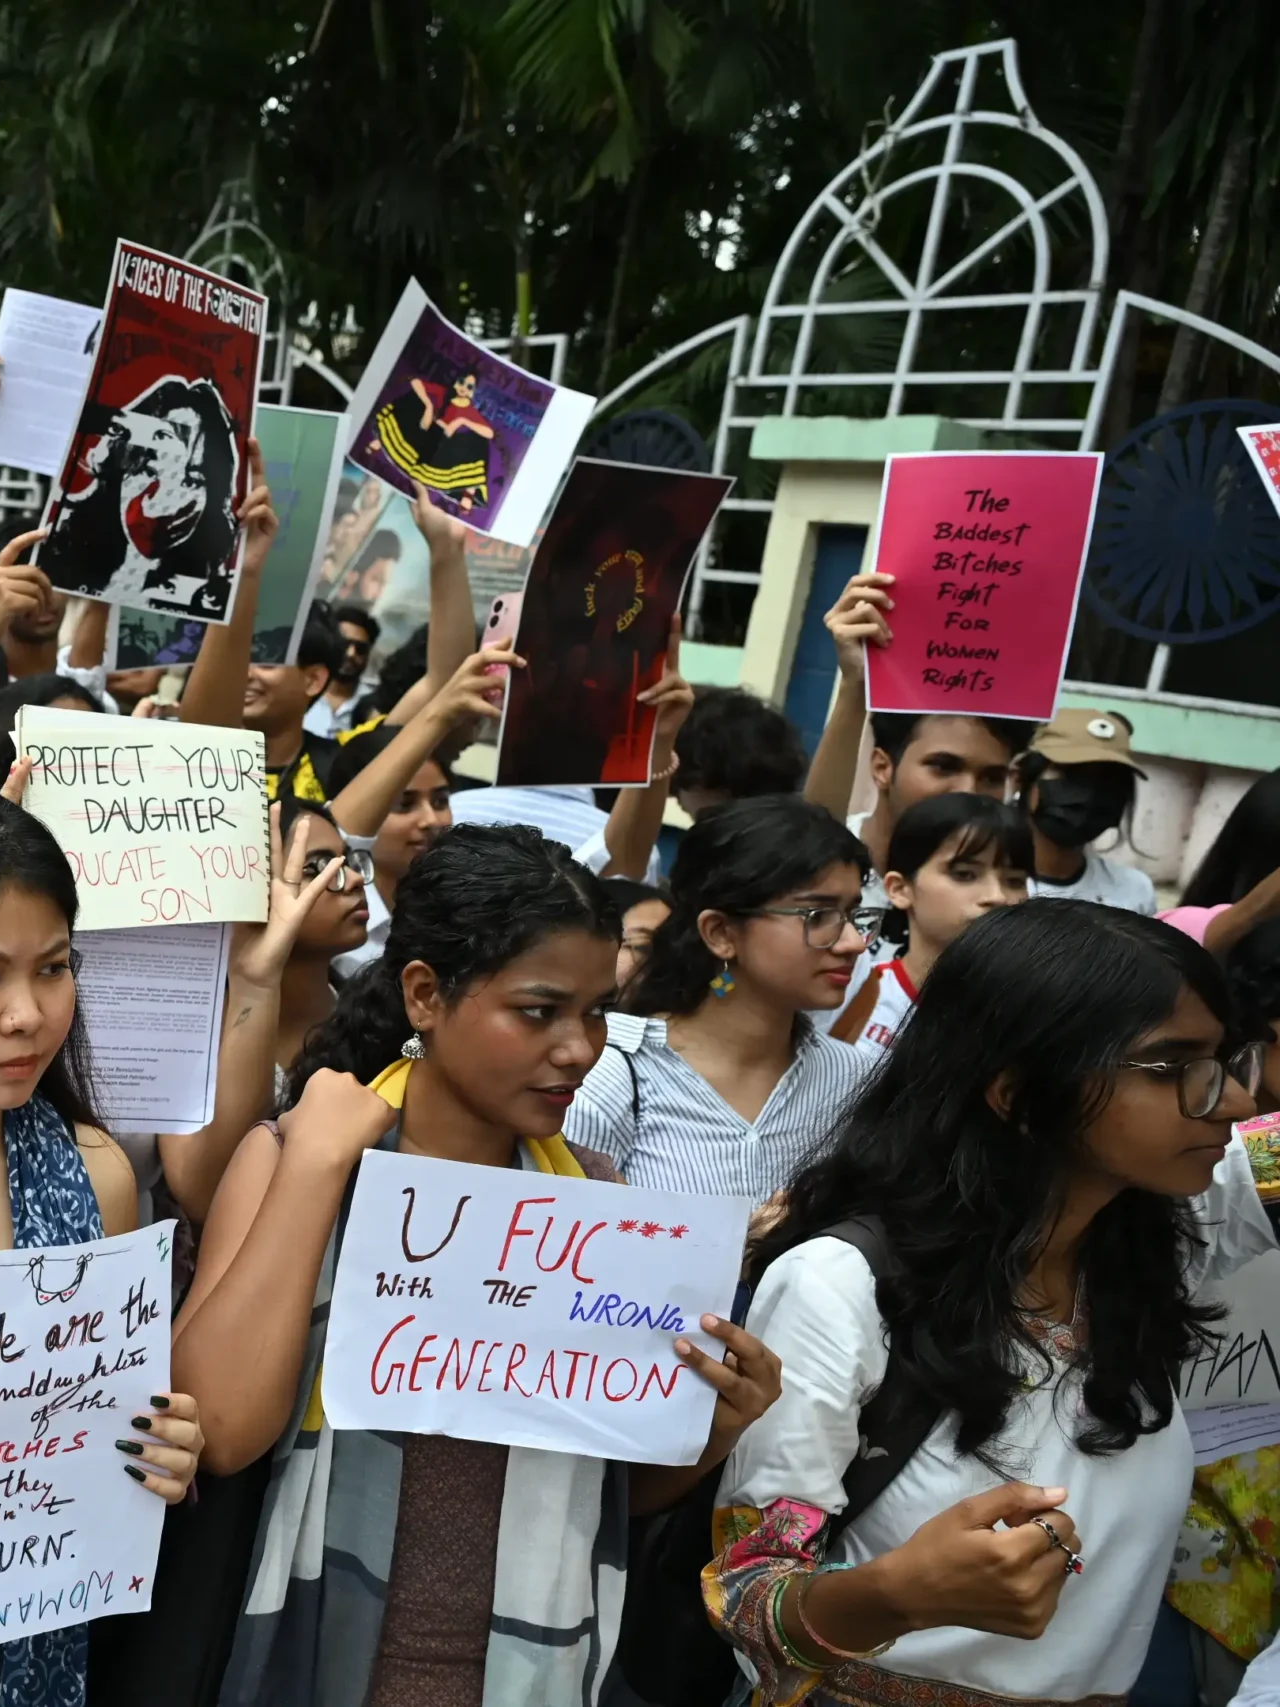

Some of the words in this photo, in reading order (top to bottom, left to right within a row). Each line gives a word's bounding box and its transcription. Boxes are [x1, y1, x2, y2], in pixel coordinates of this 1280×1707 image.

[164, 267, 182, 304] OF
[182, 273, 205, 313] THE
[964, 488, 1011, 514] The
[26, 744, 154, 787] PROTECT
[170, 744, 262, 792] YOUR
[84, 796, 237, 834] DAUGHTER
[64, 845, 166, 886] DUCATE
[190, 845, 267, 882] YOUR
[140, 885, 213, 923] SON
[401, 1186, 472, 1264] U
[44, 1307, 109, 1353] are
[120, 1276, 162, 1338] the
[376, 1271, 434, 1300] With
[482, 1279, 538, 1308] THE
[568, 1291, 686, 1333] WRONG
[370, 1314, 690, 1402] GENERATION
[30, 1400, 61, 1440] of
[68, 1388, 119, 1413] the
